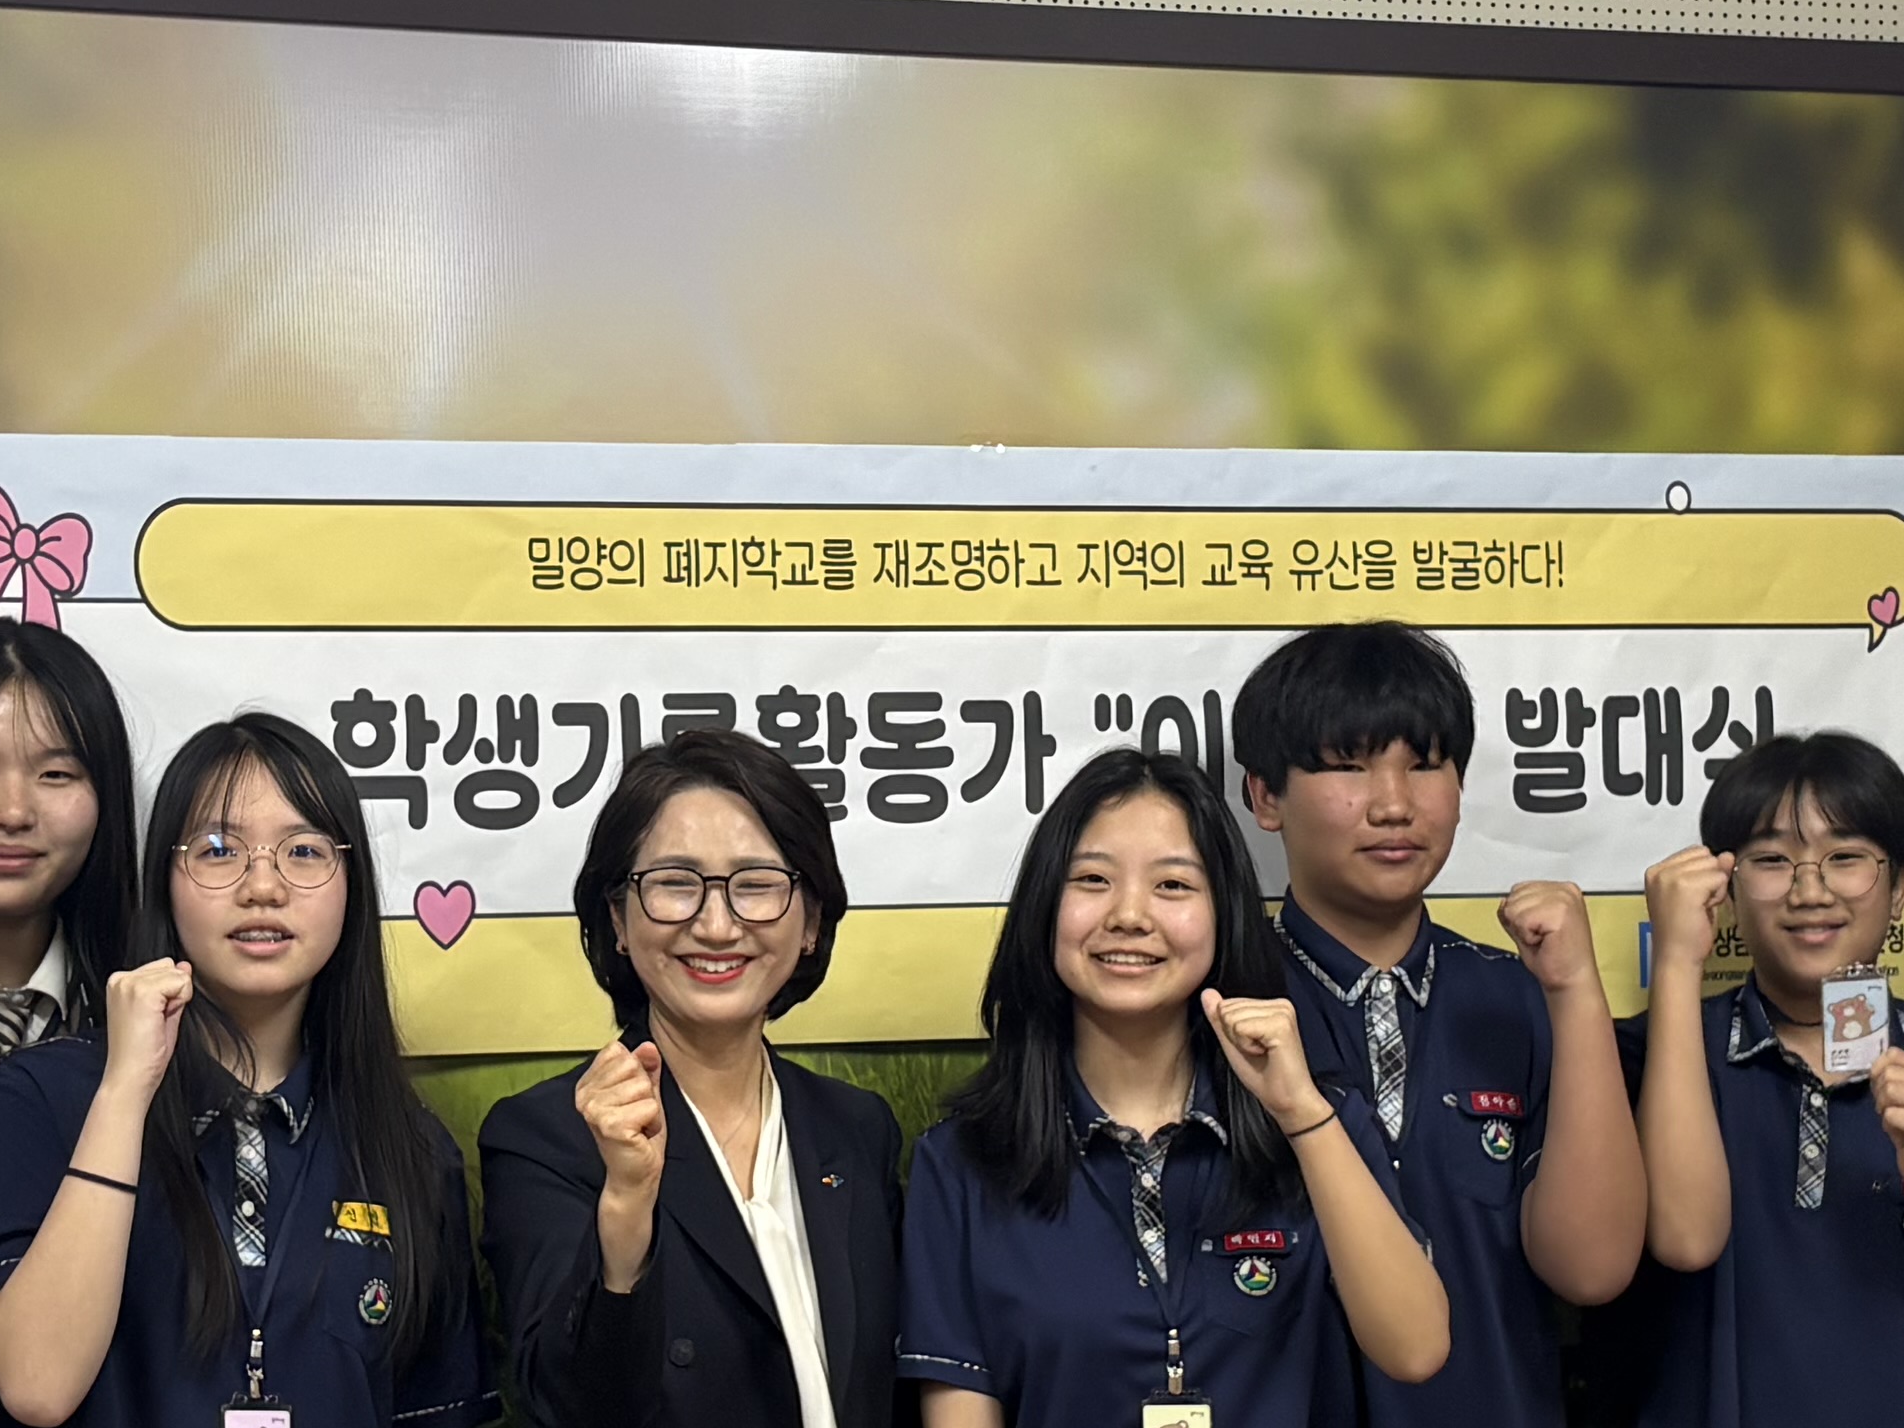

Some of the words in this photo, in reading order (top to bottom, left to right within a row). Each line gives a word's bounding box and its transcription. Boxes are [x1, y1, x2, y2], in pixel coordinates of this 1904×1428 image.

[528, 536, 644, 591] 밀양의
[663, 535, 857, 591] 폐지학교를
[873, 537, 1062, 592] 재조명하고
[1077, 538, 1184, 591] 지역의
[1201, 539, 1274, 591] 교육
[1288, 538, 1397, 591] 유산을
[1413, 539, 1564, 591] 발굴하다!
